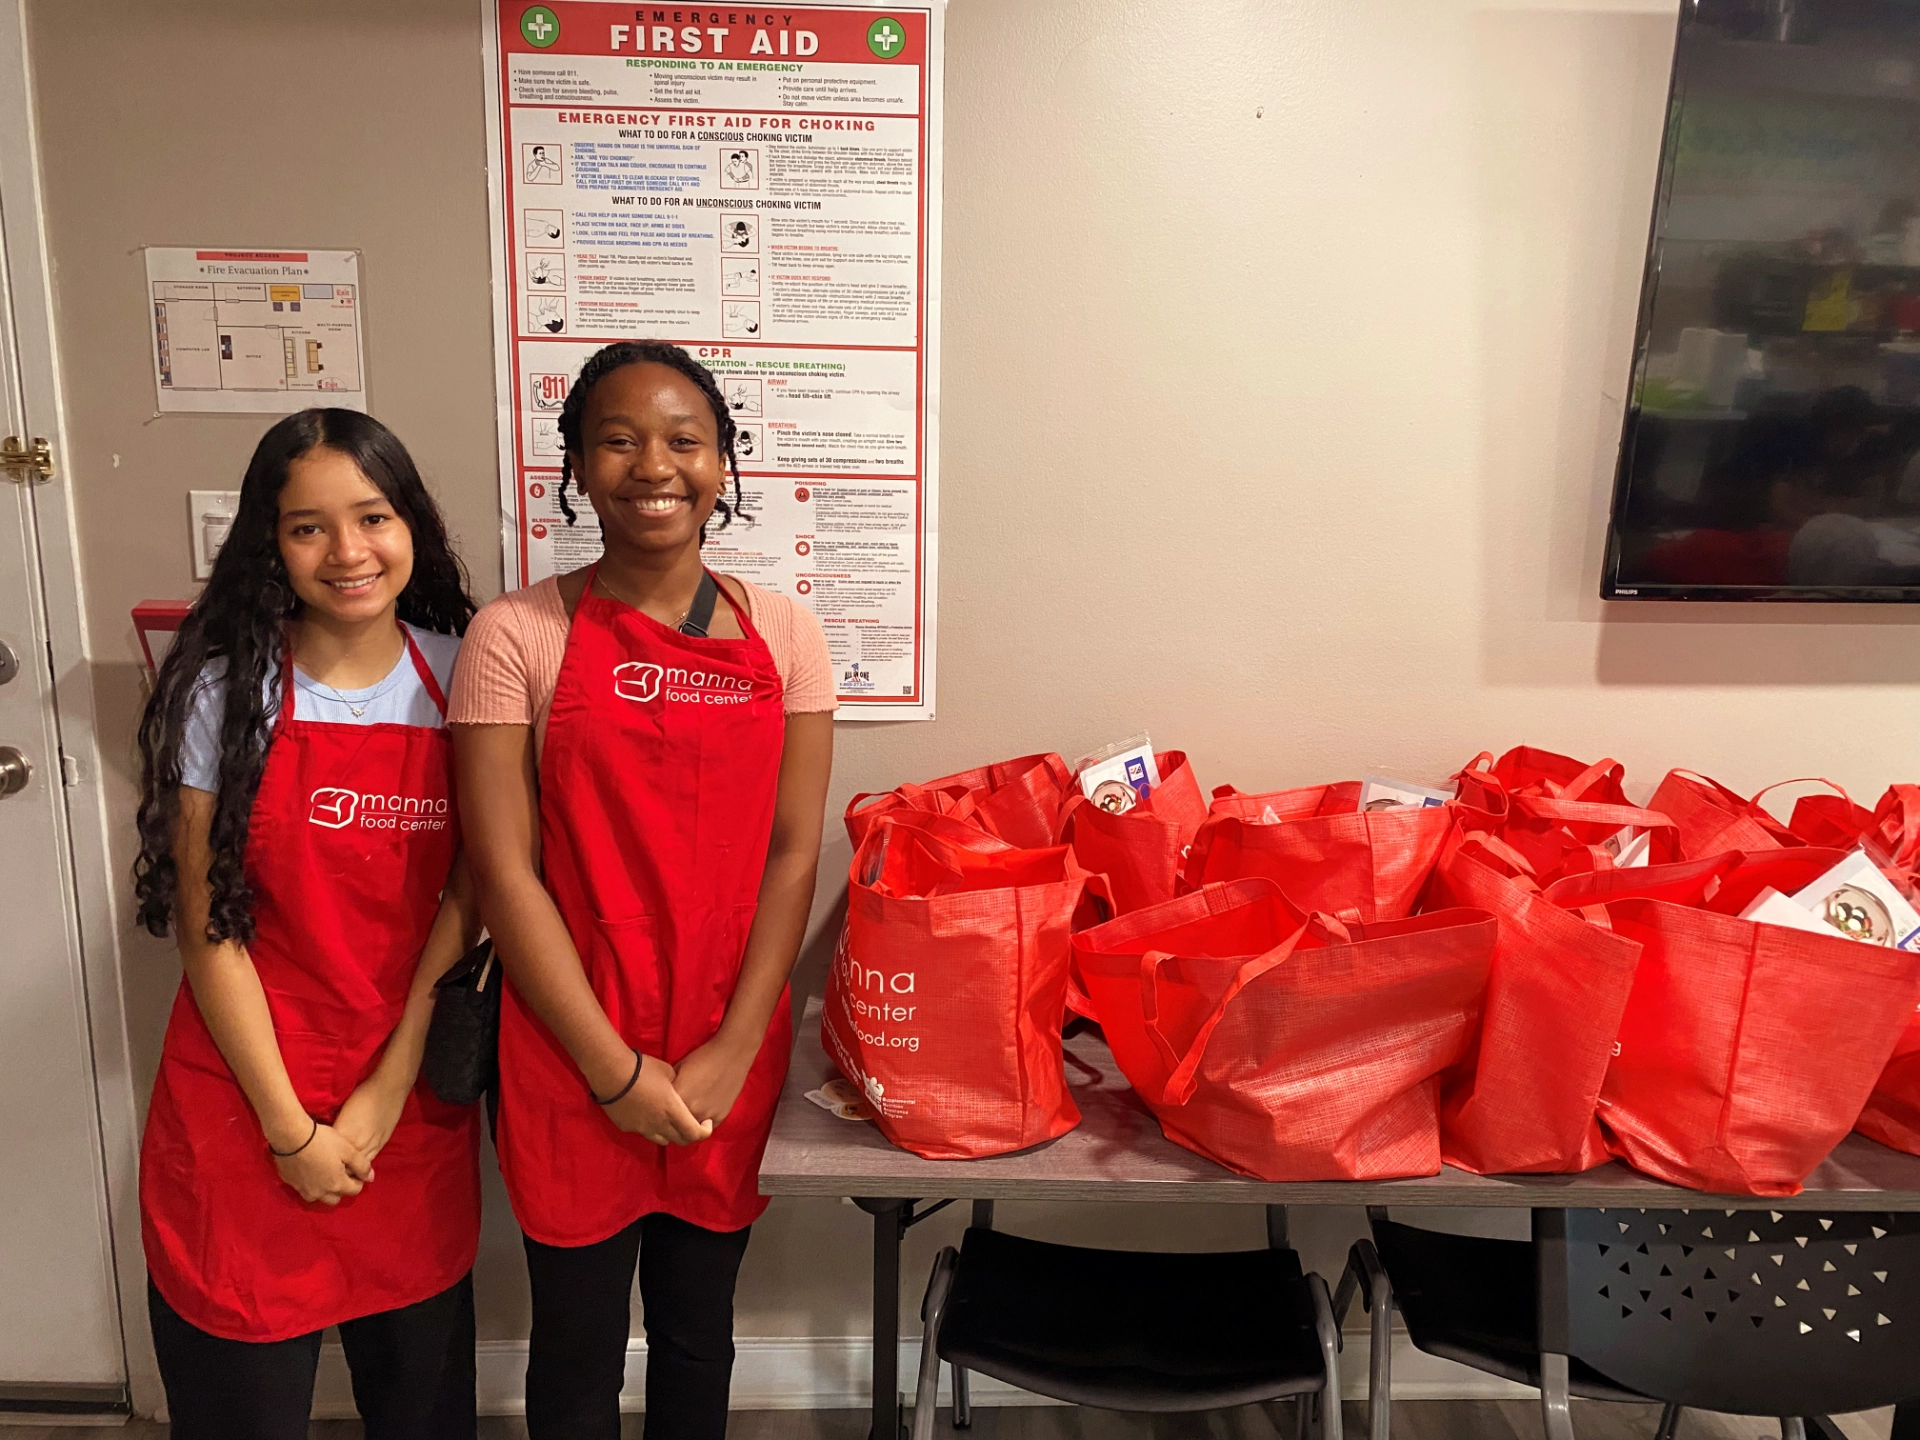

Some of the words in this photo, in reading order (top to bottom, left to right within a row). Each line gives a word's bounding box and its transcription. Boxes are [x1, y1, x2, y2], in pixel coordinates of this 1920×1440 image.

[635, 10, 793, 26] EMERGENCY
[610, 24, 729, 53] FIRST
[749, 29, 820, 56] AID
[625, 58, 697, 70] RESPONDING
[699, 61, 715, 70] TO
[718, 61, 734, 71] AN
[736, 62, 803, 73] EMERGENCY
[654, 72, 673, 82] Moving
[674, 73, 706, 81] unconscious
[724, 75, 735, 83] may
[782, 76, 791, 84] Put
[800, 77, 822, 86] personal
[824, 77, 848, 86] protective
[850, 78, 878, 87] equipment.
[654, 79, 669, 88] spinal
[670, 80, 685, 88] injury
[536, 86, 551, 94] victim
[579, 88, 603, 96] bleeding,
[603, 88, 619, 96] pulse,
[674, 87, 684, 95] first
[828, 86, 838, 94] help
[519, 93, 543, 101] breathing
[783, 100, 793, 108] Stay
[558, 112, 661, 127] EMERGENCY
[668, 114, 716, 128] FIRST
[724, 115, 752, 129] AID
[759, 116, 792, 130] FOR
[798, 117, 875, 132] CHOKING
[618, 129, 642, 140] WHAT
[644, 130, 655, 140] TO
[657, 130, 669, 140] DO
[671, 130, 688, 141] FOR
[689, 131, 696, 141] A
[697, 131, 744, 142] CONSCIOUS
[746, 132, 783, 143] CHOKING
[784, 134, 813, 144] VICTIM
[611, 196, 635, 206] WHAT
[637, 197, 648, 206] TO
[650, 197, 662, 207] DO
[664, 197, 680, 207] FOR
[682, 198, 694, 207] AN
[695, 198, 753, 209] UNCONSCIOUS
[755, 200, 792, 210] CHOKING
[793, 201, 822, 210] VICTIM
[207, 265, 225, 276] Fire
[228, 265, 279, 277] Evacuation
[281, 266, 303, 277] Plan
[698, 347, 732, 358] CPR
[755, 360, 790, 370] RESCUE
[793, 361, 846, 371] BREATHING)
[542, 375, 566, 400] 911
[777, 455, 790, 464] Keep
[791, 456, 806, 465] giving
[826, 456, 832, 464] 30
[833, 456, 867, 465] compressions
[824, 617, 846, 625] RESCUE
[848, 617, 879, 625] BREATHING
[666, 668, 754, 691] manna
[666, 689, 700, 703] food
[361, 794, 447, 813] manna
[360, 815, 396, 829] food
[400, 820, 446, 831] center
[850, 993, 917, 1022] center
[882, 1097, 916, 1105] Supplemental
